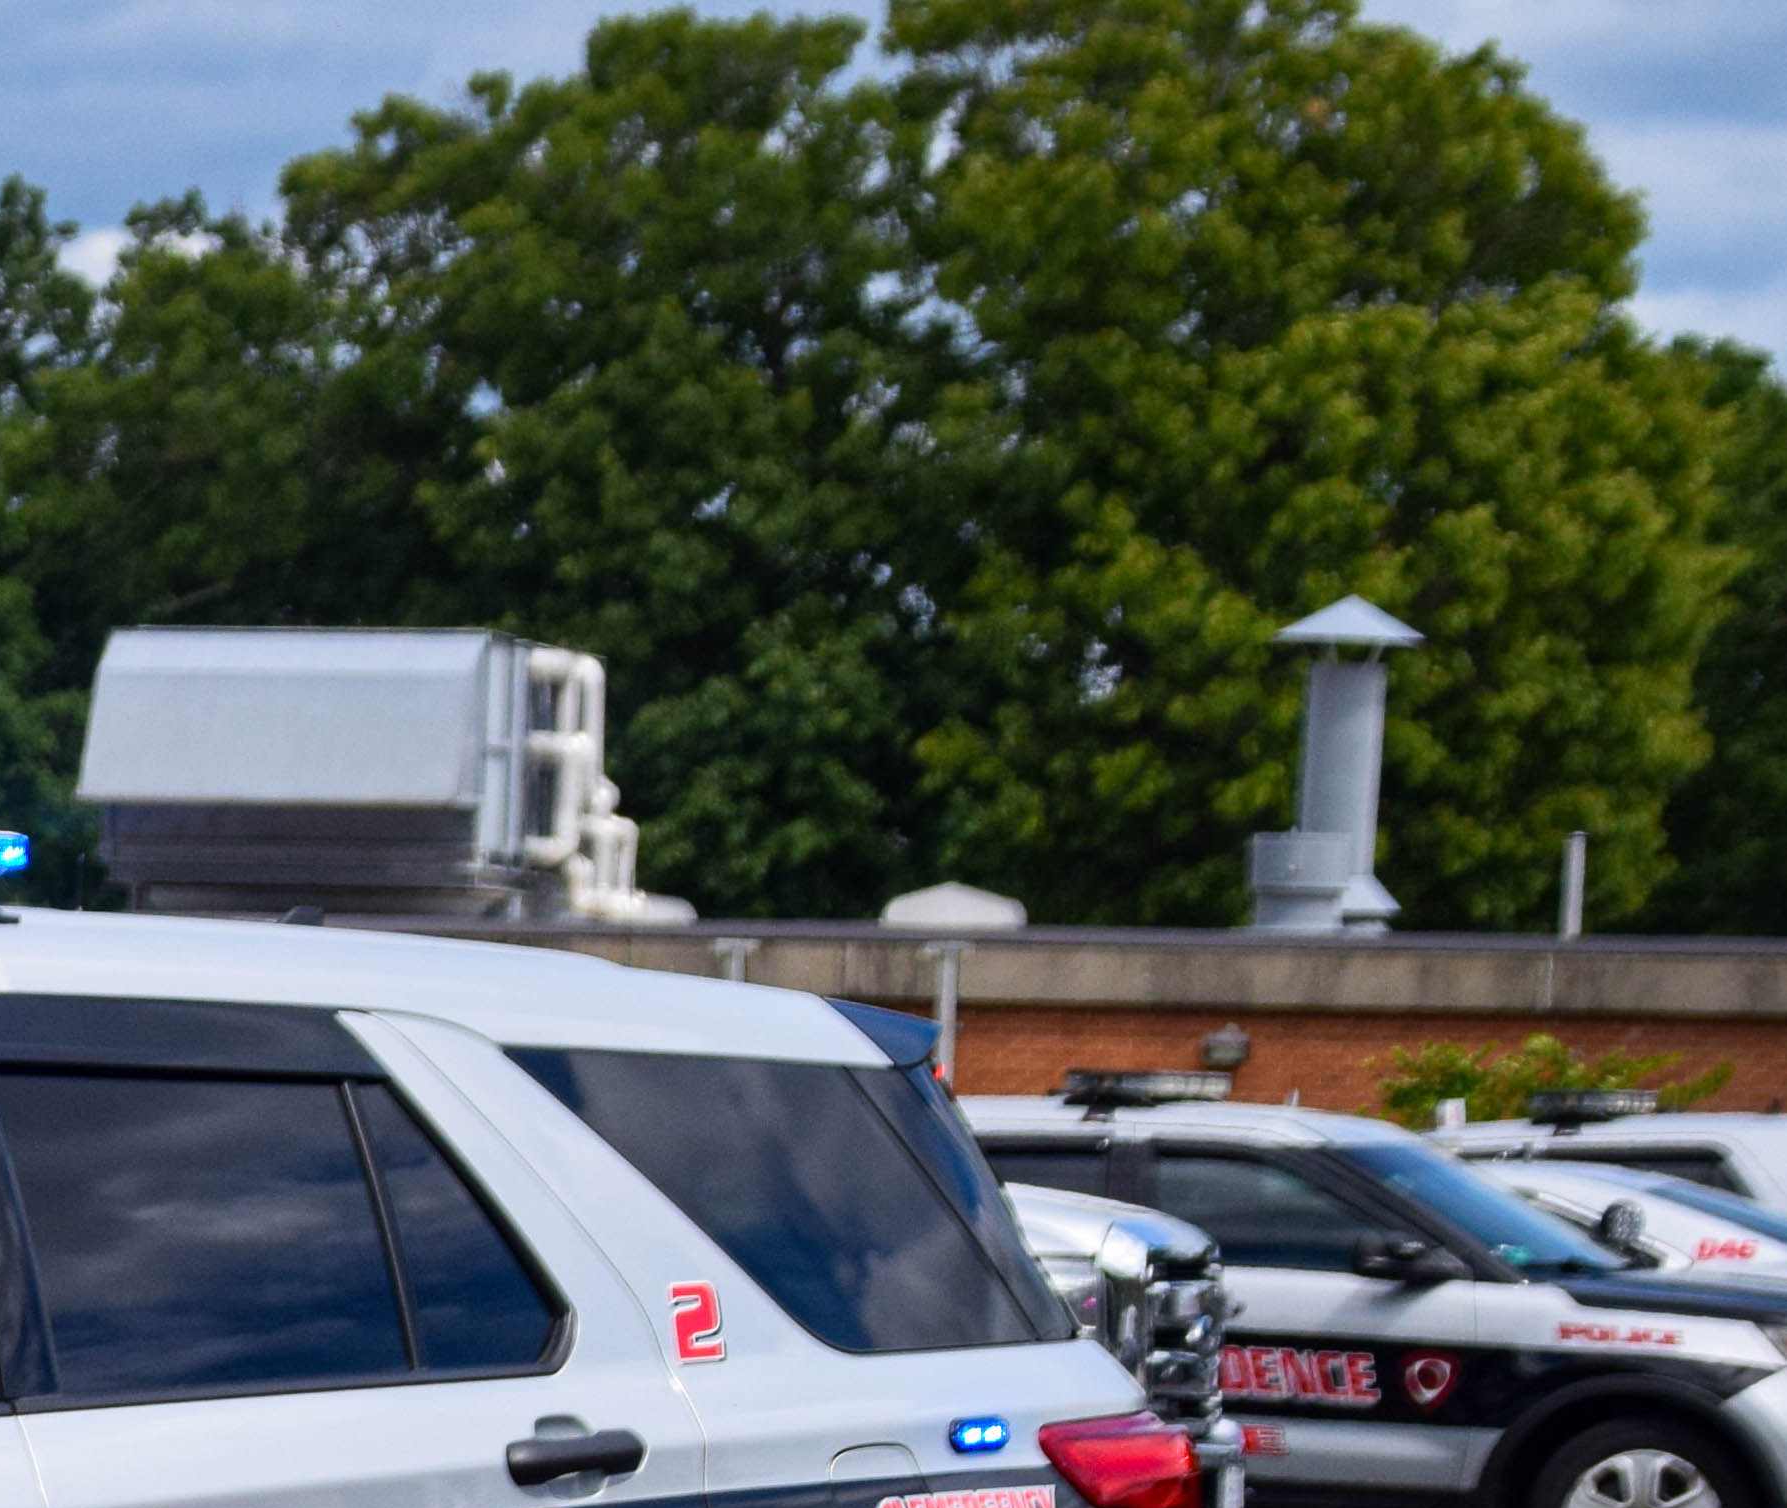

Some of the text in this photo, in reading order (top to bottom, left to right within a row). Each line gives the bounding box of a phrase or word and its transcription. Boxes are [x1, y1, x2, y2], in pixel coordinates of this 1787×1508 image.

[667, 1280, 727, 1365] 2
[1557, 1320, 1685, 1345] POLICE
[1218, 1344, 1381, 1408] DENCE
